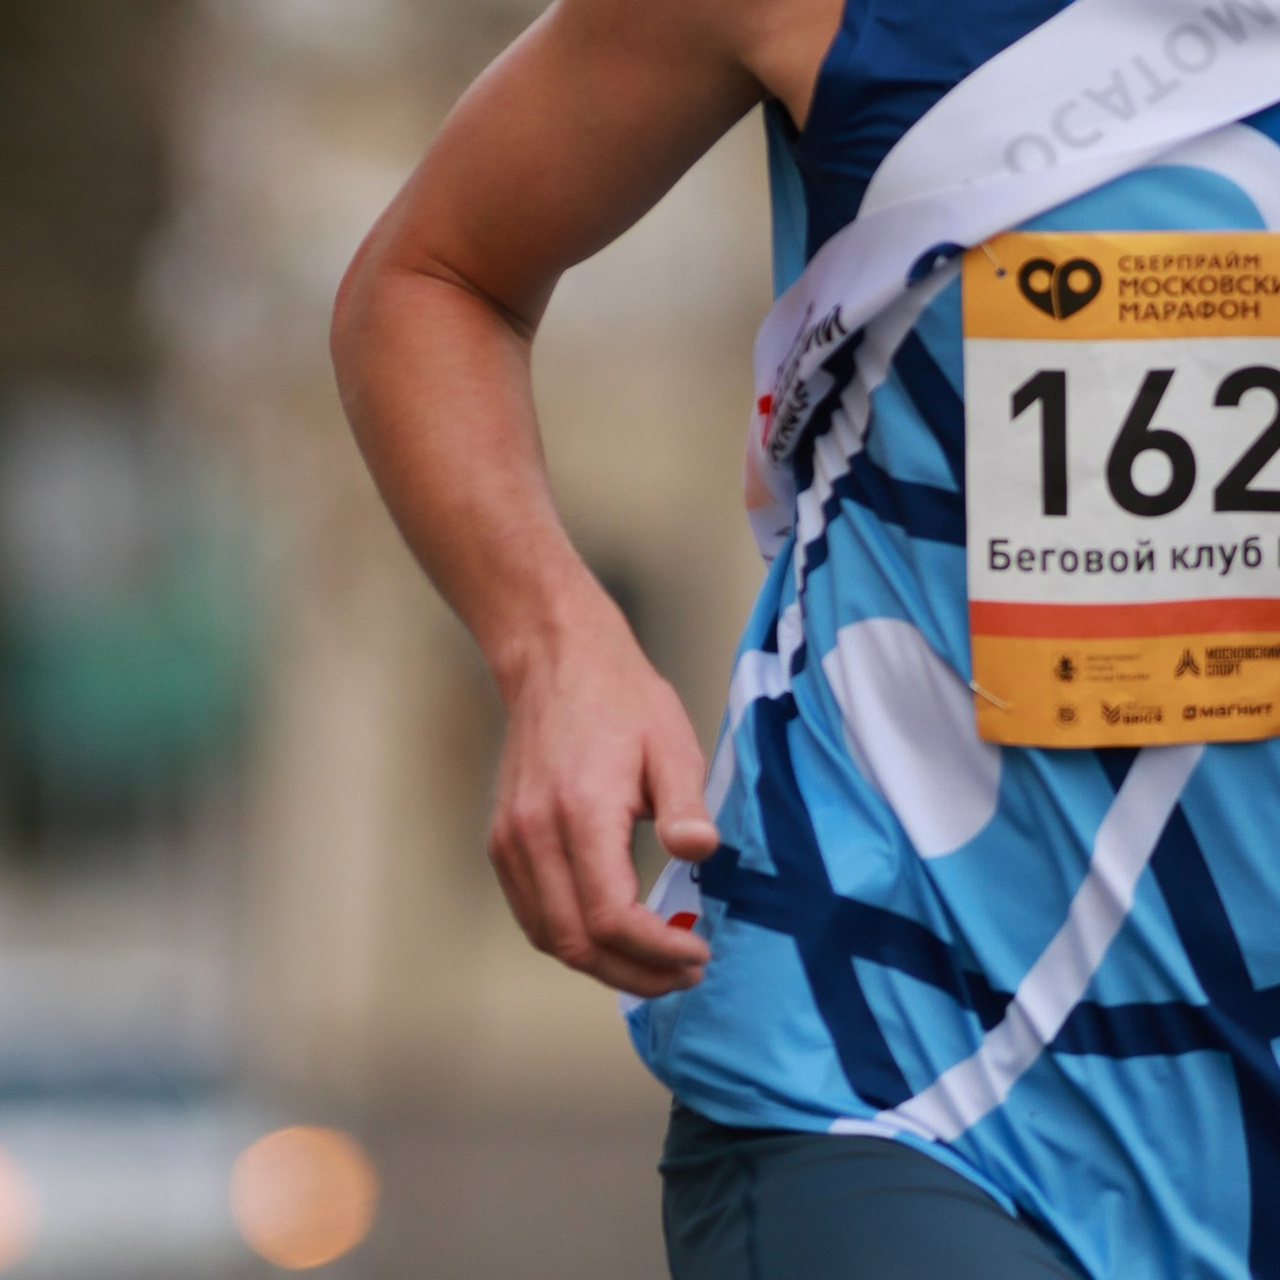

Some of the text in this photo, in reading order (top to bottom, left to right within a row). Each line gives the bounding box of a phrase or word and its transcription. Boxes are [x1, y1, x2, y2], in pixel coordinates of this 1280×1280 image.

[1118, 251, 1260, 273] СБЕРПРАЙМ
[1118, 298, 1261, 322] МАРАФОН
[989, 537, 1154, 573] Беговой
[1171, 534, 1263, 577] клуб
